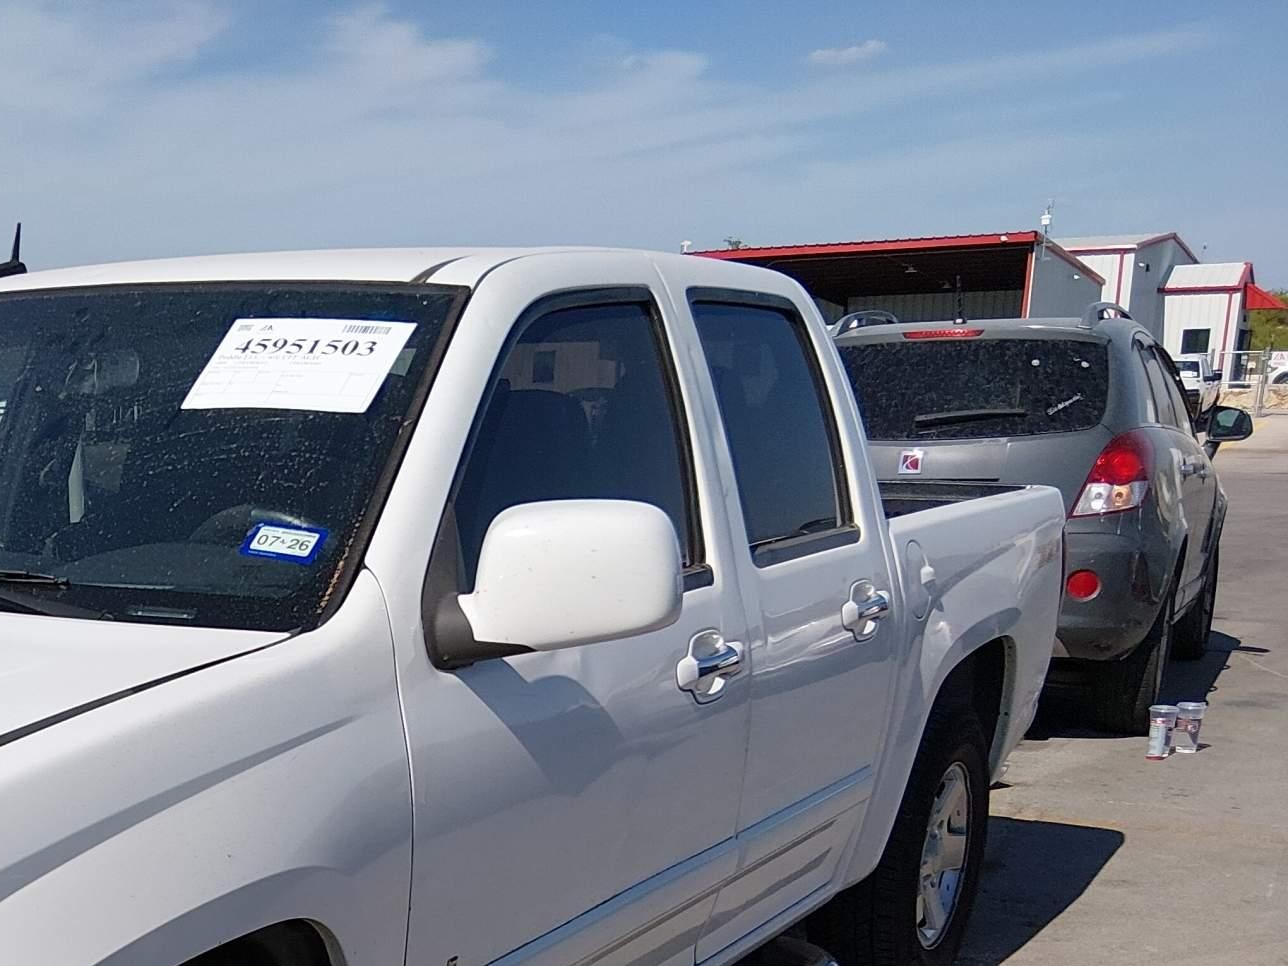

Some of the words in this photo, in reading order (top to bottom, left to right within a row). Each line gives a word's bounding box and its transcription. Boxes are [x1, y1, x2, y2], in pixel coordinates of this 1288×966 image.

[234, 337, 378, 357] 45951503
[256, 534, 281, 547] 07
[287, 538, 312, 552] 26
